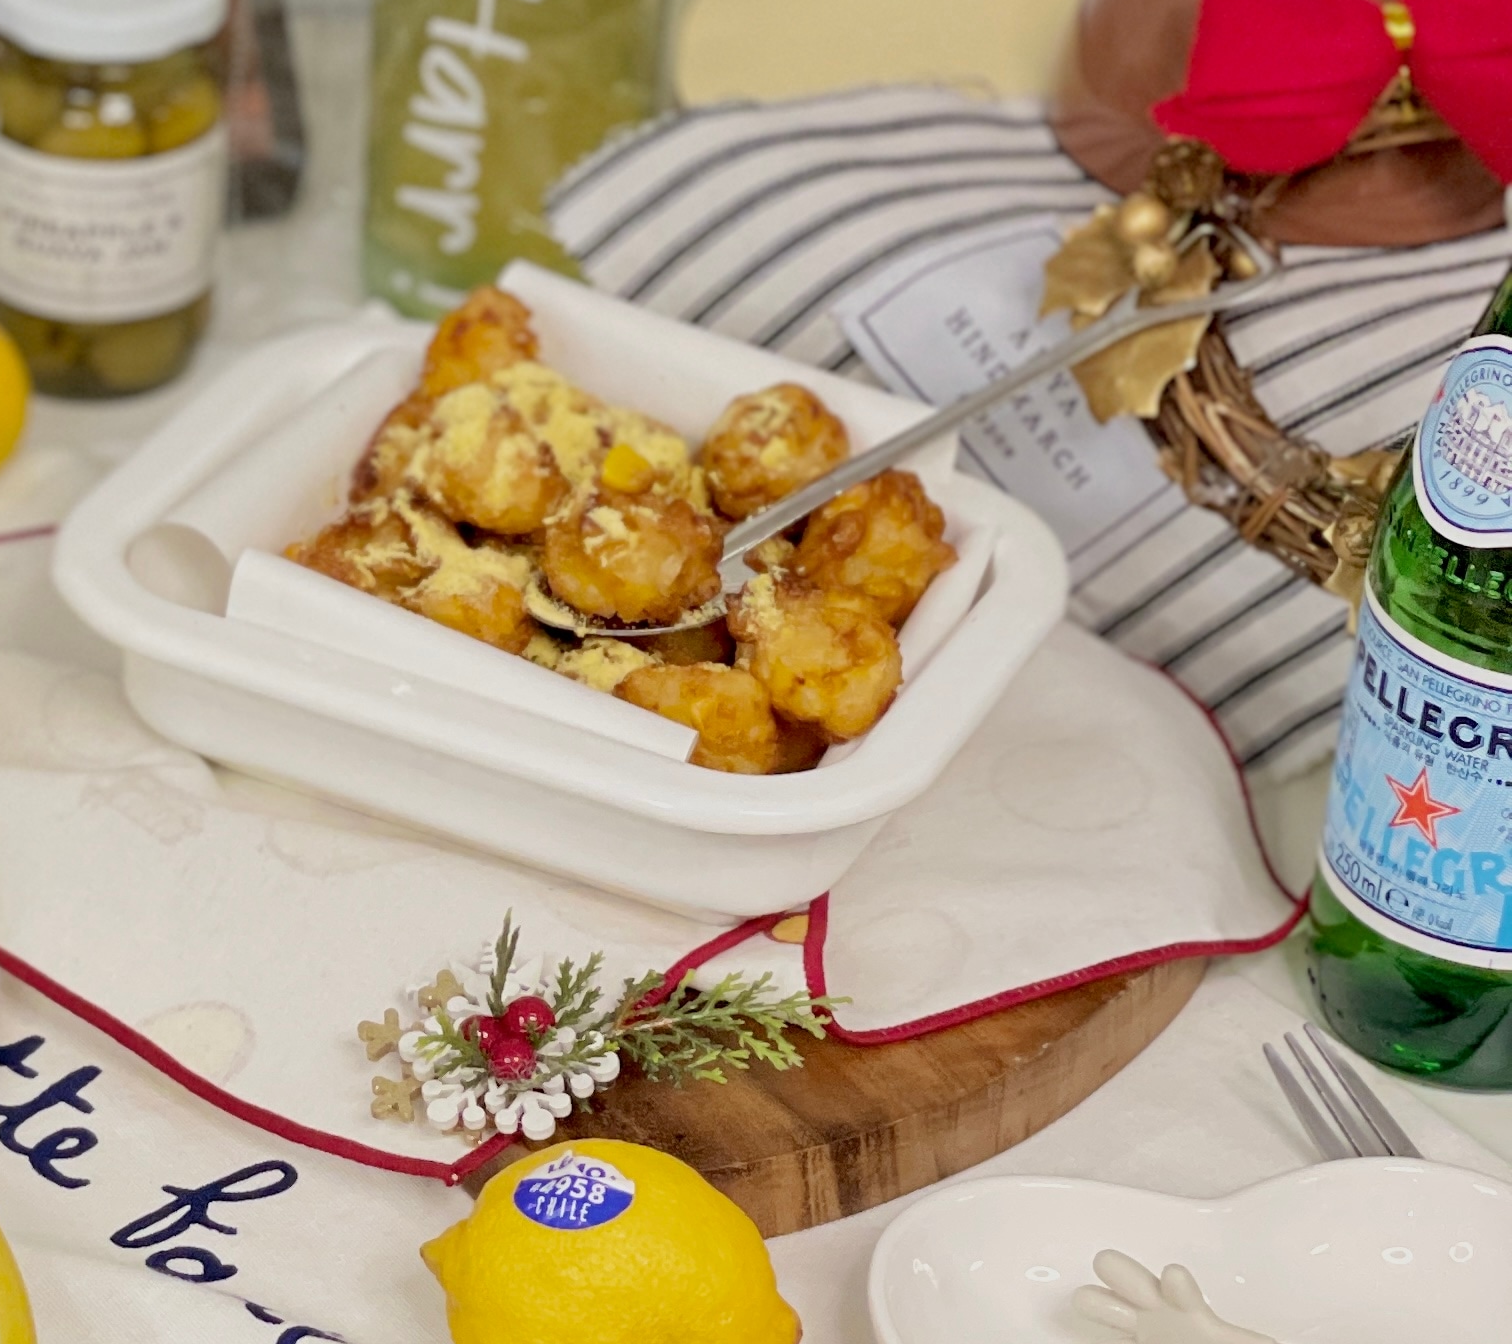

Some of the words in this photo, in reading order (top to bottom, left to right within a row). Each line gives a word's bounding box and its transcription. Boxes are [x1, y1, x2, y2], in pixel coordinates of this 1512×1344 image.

[1009, 326, 1082, 418] AYA
[1438, 469, 1490, 505] 1899
[1422, 674, 1501, 713] PELLEGRINO
[1383, 712, 1440, 756] SPARKLING
[1444, 745, 1489, 772] WATER
[534, 1195, 592, 1224] CHILE
